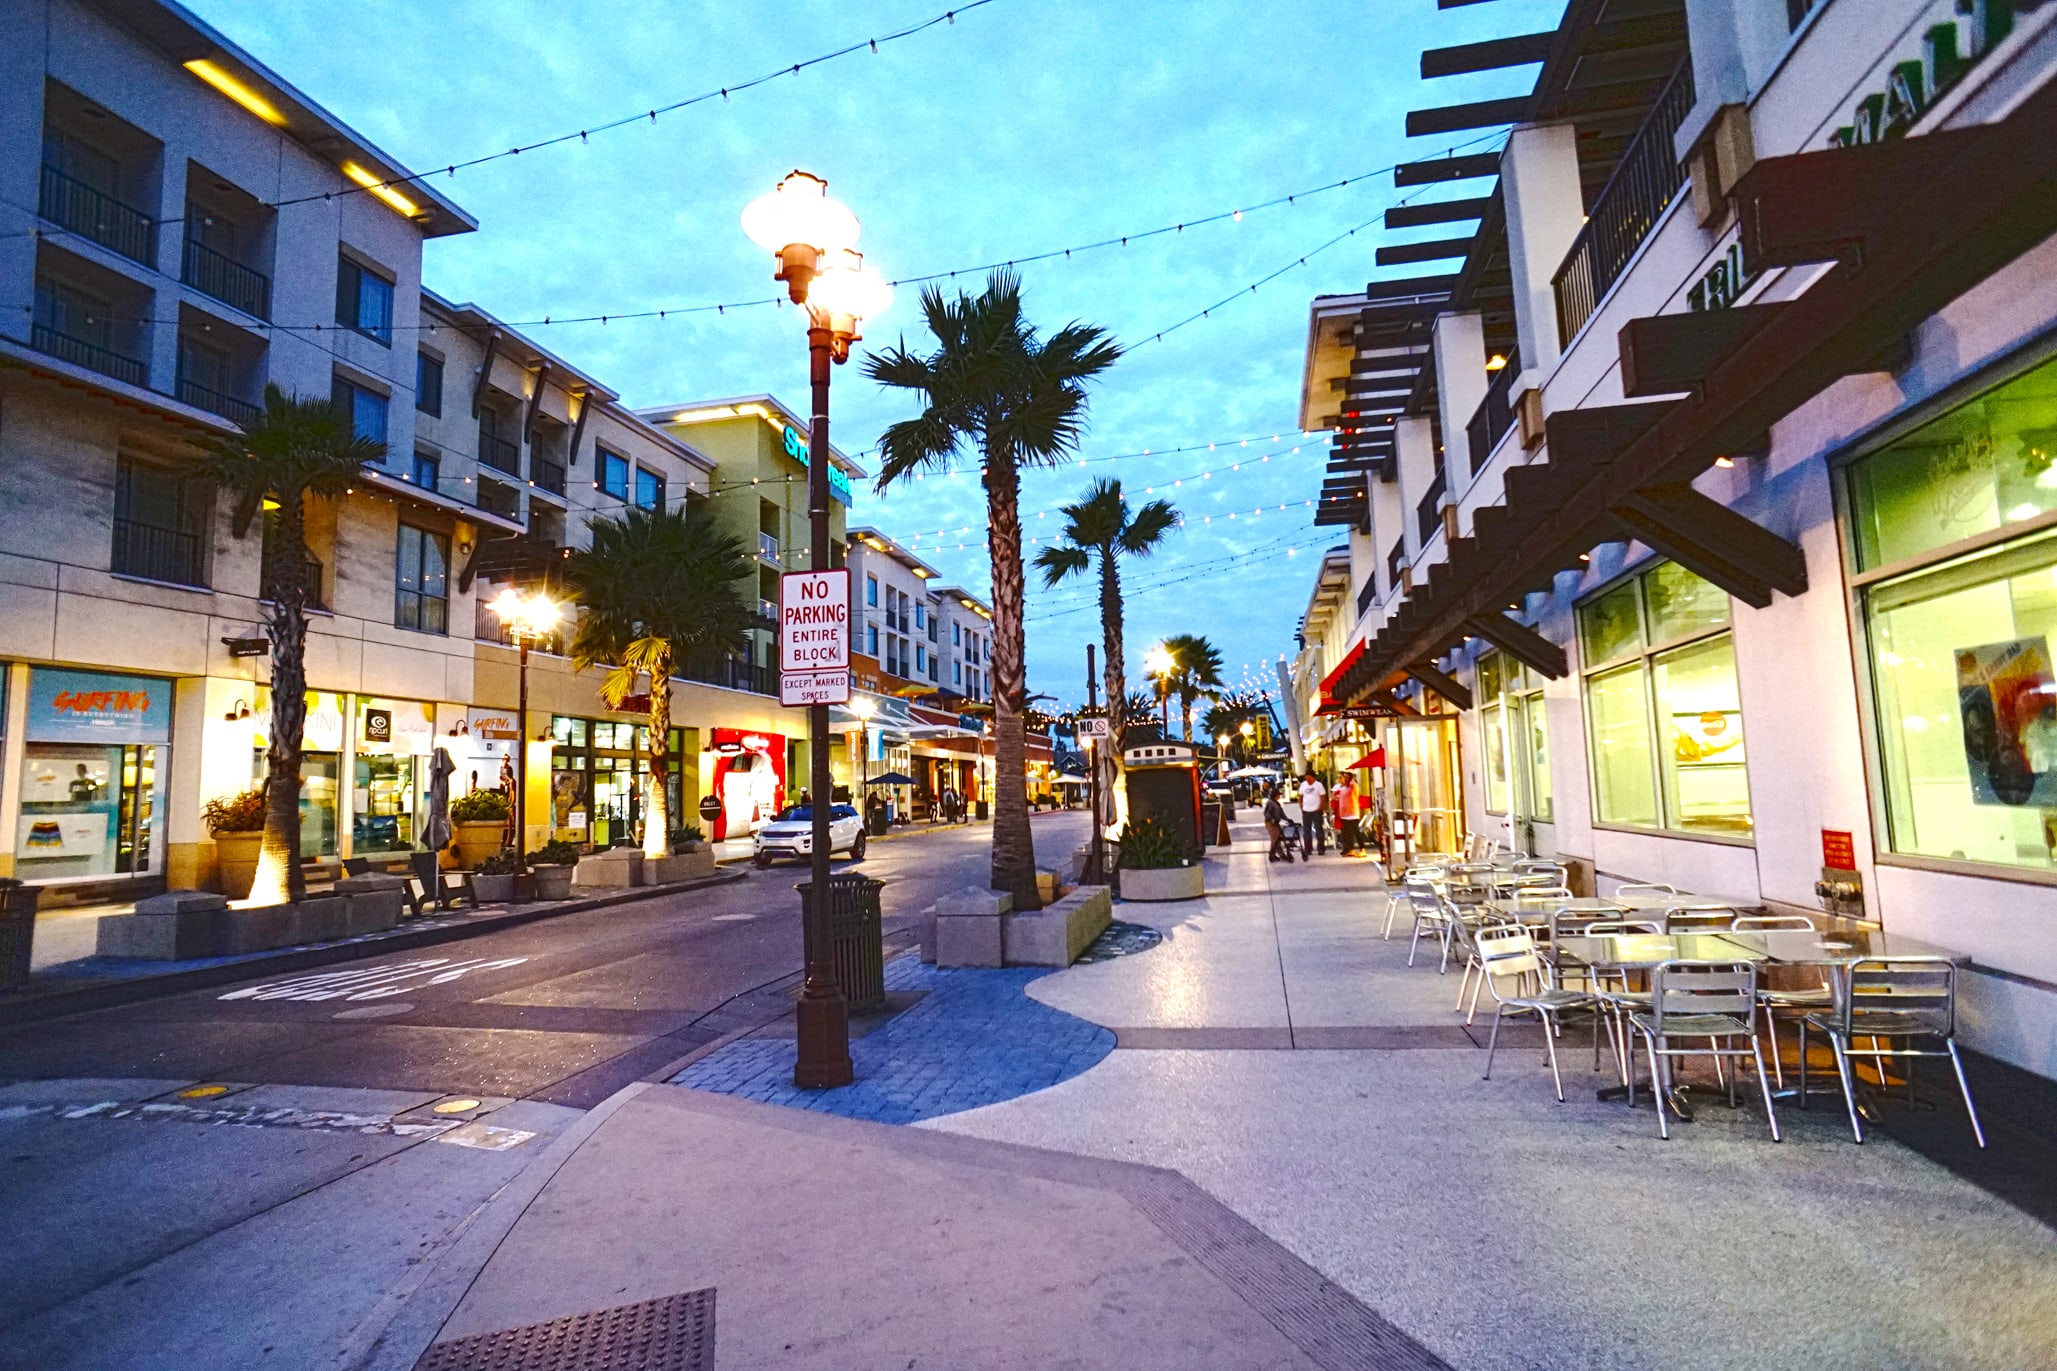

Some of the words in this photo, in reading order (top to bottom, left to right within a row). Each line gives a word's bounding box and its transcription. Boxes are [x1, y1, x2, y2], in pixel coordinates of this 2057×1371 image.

[801, 580, 829, 600] NO
[785, 603, 846, 625] PARKING
[792, 628, 838, 643] ENTIRE
[793, 646, 838, 661] BLOCK
[784, 679, 812, 689] EXCEPT
[815, 677, 846, 687] MARKED
[51, 690, 150, 715] SURFING
[801, 690, 829, 701] SPACES
[473, 717, 509, 732] SURFING
[1080, 720, 1093, 733] NO
